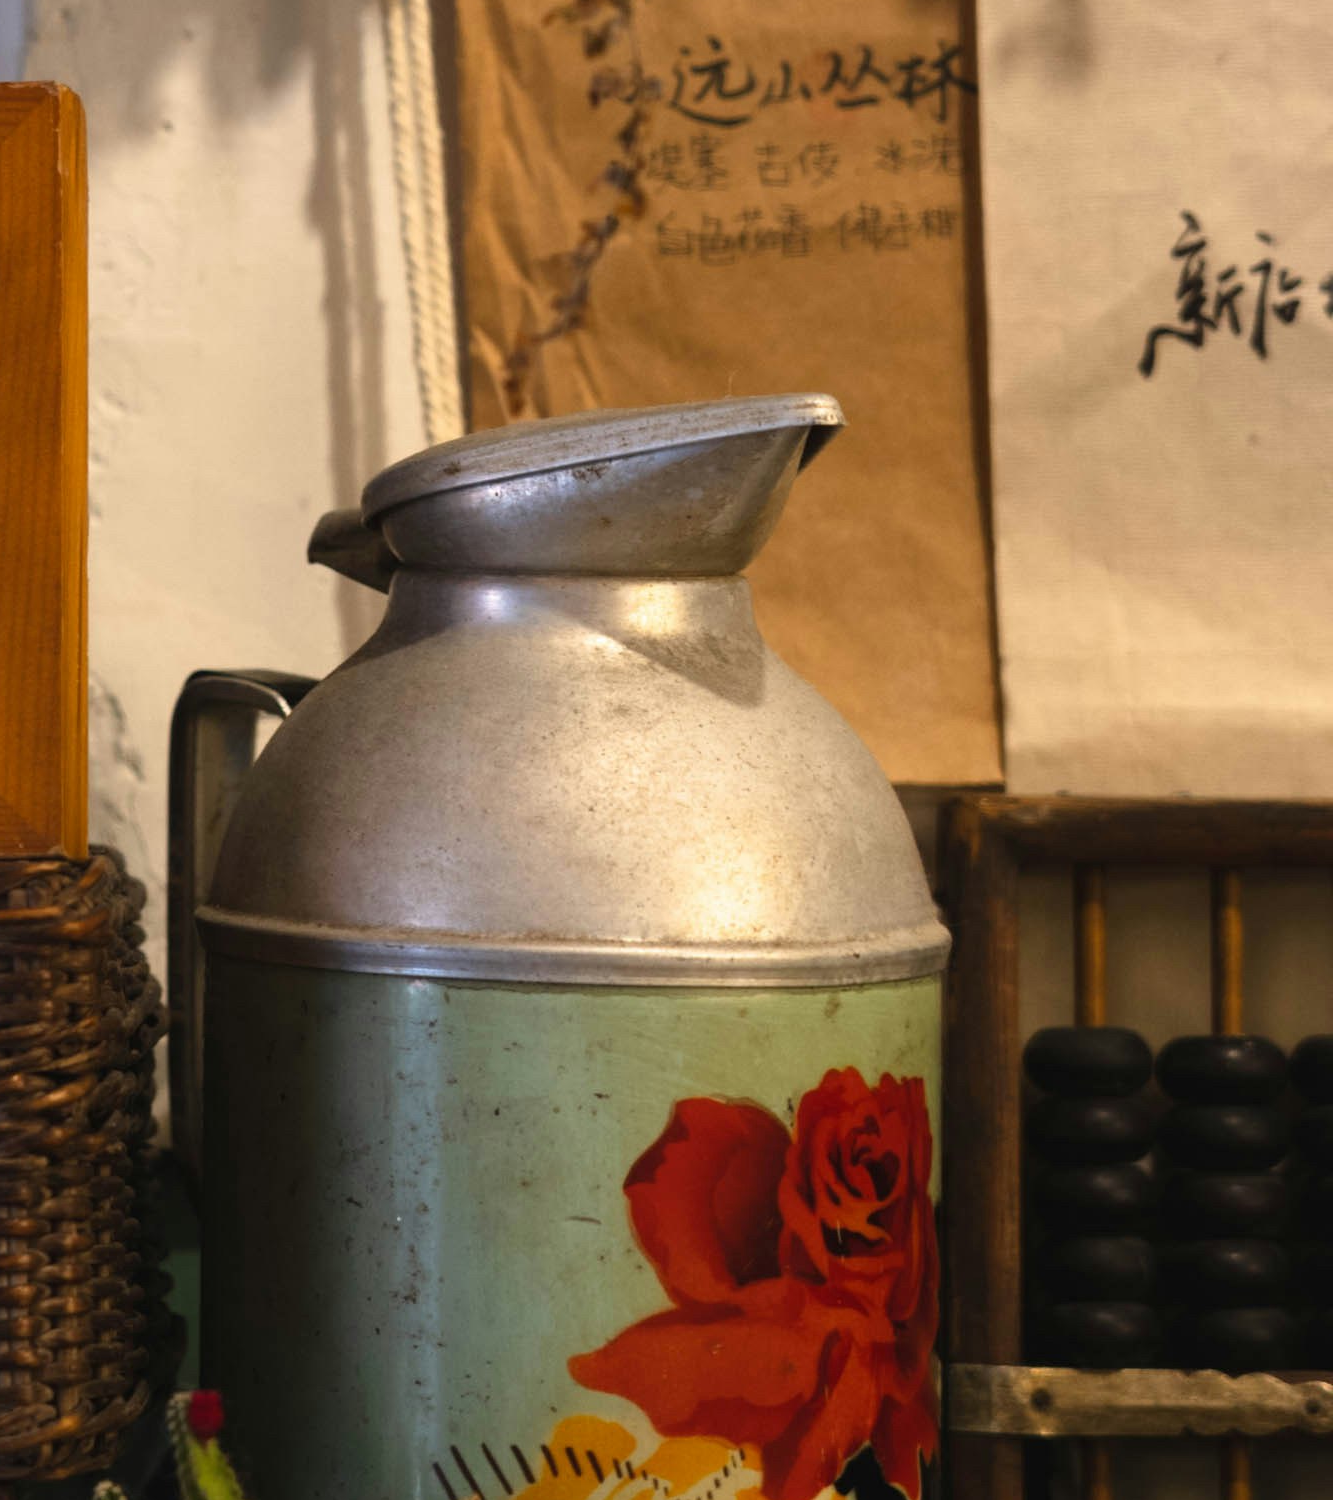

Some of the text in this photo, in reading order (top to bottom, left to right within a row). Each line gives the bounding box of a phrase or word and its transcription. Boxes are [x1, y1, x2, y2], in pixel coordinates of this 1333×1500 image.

[668, 35, 978, 130] 远山丛林
[1136, 206, 1333, 380] 新店
